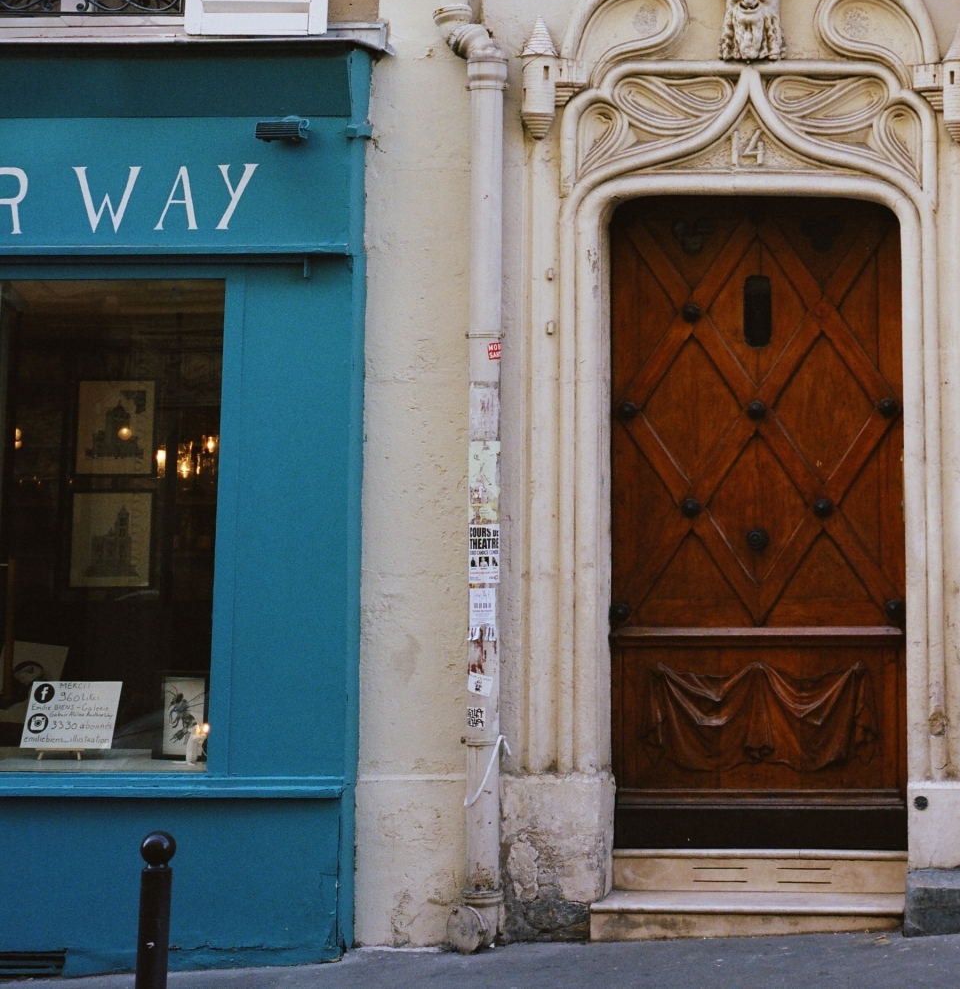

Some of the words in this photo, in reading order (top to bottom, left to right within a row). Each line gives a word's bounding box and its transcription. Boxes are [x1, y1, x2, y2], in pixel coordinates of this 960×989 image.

[732, 128, 765, 167] 14
[72, 163, 260, 234] WAY
[59, 692, 80, 702] 960
[51, 720, 78, 730] 3330
